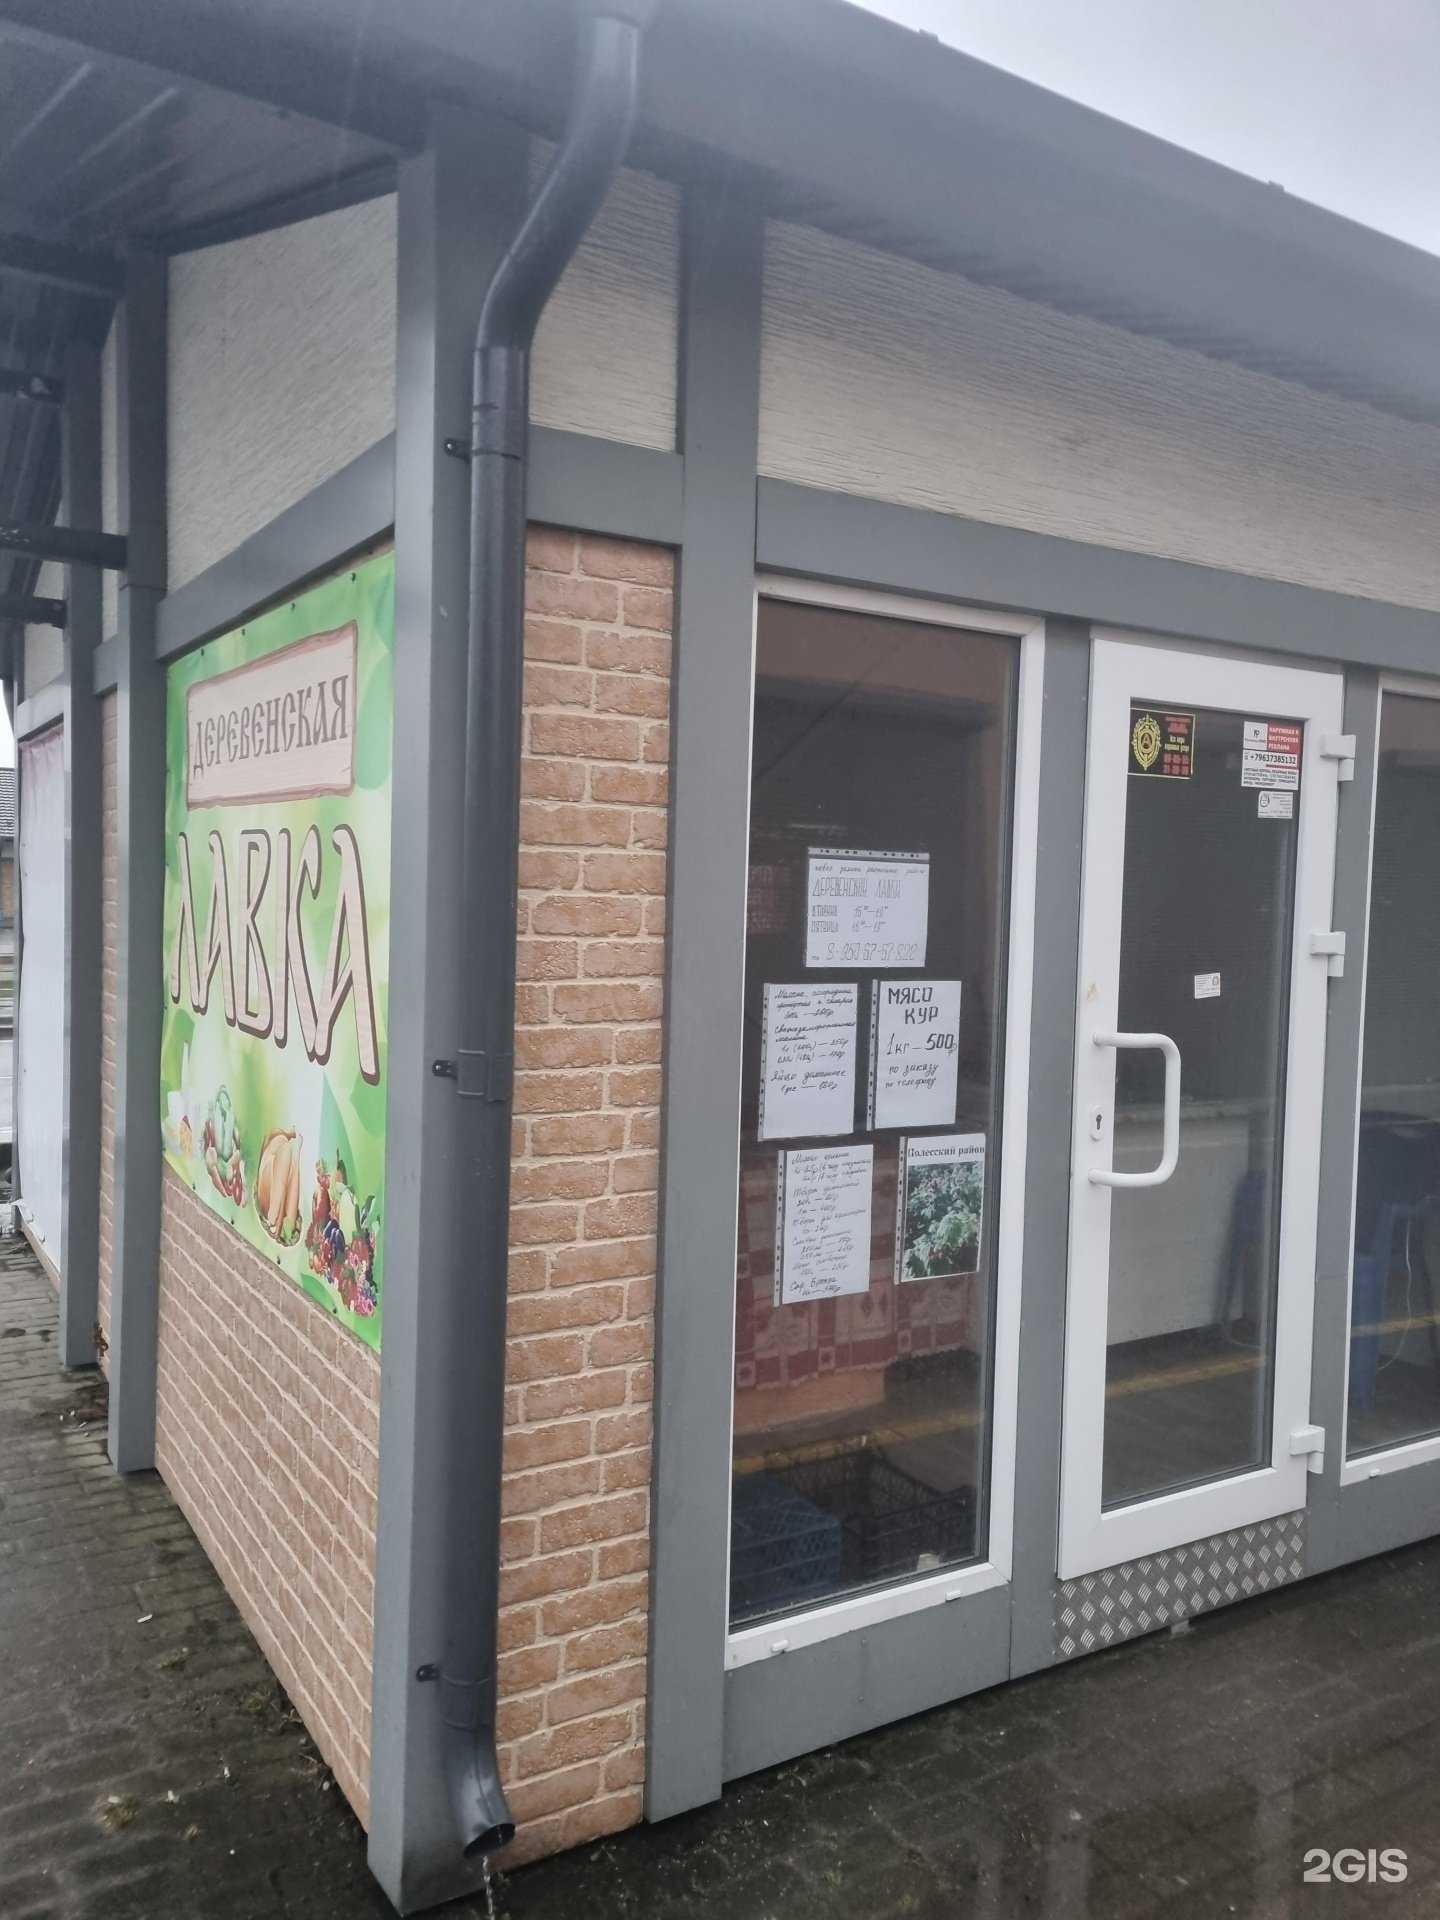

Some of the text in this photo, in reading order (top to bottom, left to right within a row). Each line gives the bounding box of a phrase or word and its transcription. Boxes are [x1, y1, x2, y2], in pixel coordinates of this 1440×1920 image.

[192, 675, 349, 776] ДЕРЕВЕНСКАЯ
[171, 824, 380, 1086] ЛАВКА
[888, 987, 933, 1005] МЯСО
[905, 1006, 939, 1025] КУР
[902, 1063, 939, 1077] заказу
[908, 1144, 985, 1158] Полесский район
